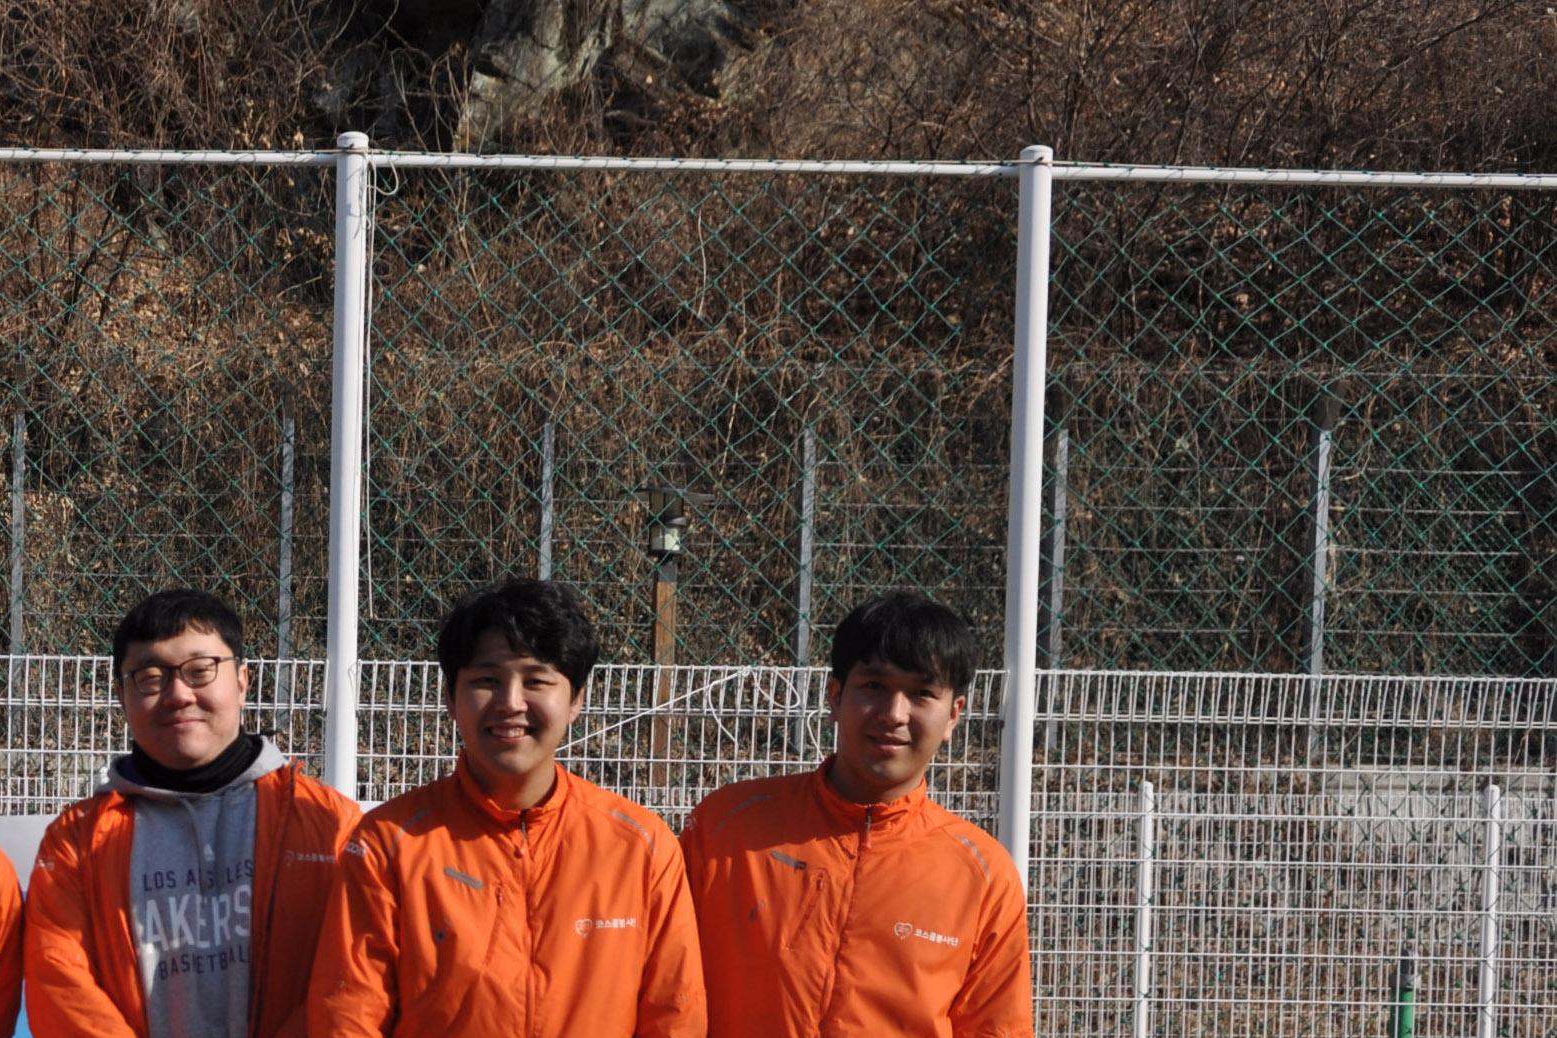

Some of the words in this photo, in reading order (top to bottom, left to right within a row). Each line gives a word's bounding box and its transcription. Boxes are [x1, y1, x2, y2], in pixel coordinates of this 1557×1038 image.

[143, 870, 176, 891] LOS
[186, 859, 254, 888] AGLES
[133, 884, 251, 951] AKERS
[159, 944, 251, 980] BASETBAL
